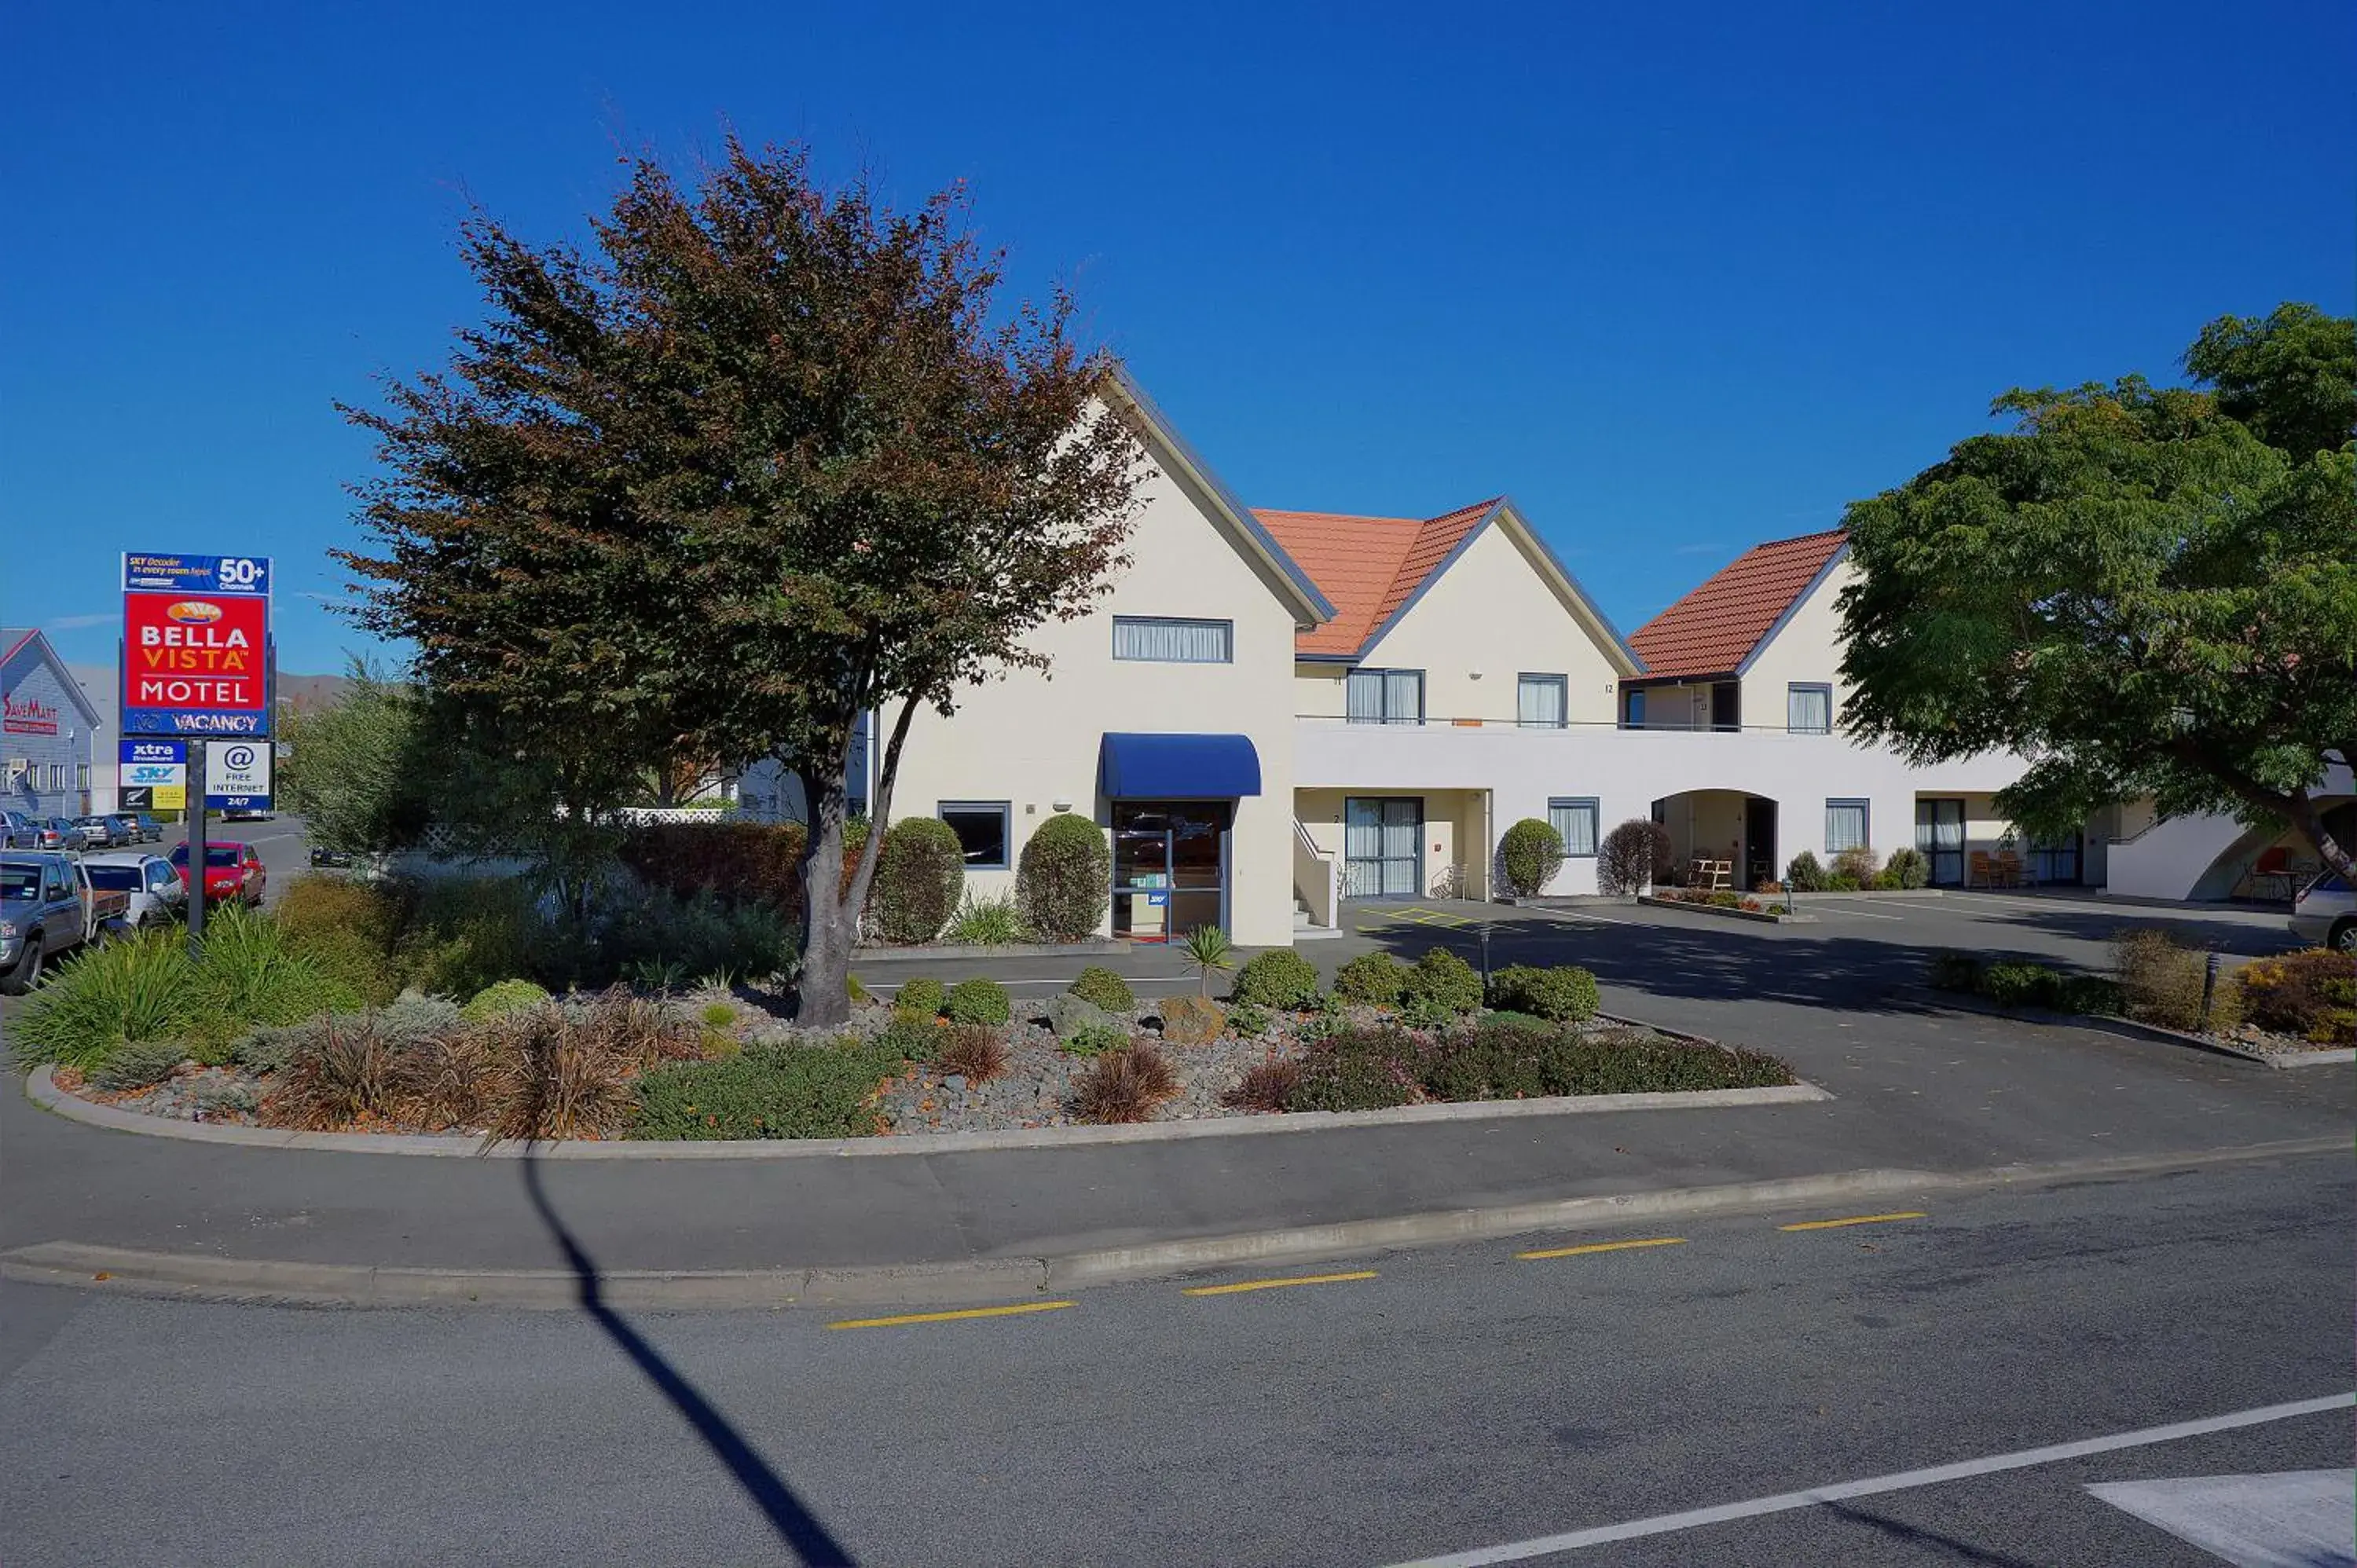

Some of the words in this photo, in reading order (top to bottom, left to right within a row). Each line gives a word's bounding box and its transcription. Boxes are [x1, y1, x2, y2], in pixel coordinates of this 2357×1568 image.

[142, 567, 167, 576] every
[219, 559, 265, 583] 50+
[141, 626, 249, 648] BELLA
[142, 648, 244, 670] VISTA
[141, 681, 249, 703] MOTEL
[171, 714, 258, 732] VACANCY
[133, 744, 174, 755] xtra
[130, 766, 177, 779] SKY
[225, 773, 252, 782] FREE
[213, 784, 265, 793] INTERNET
[227, 797, 249, 807] 24/7
